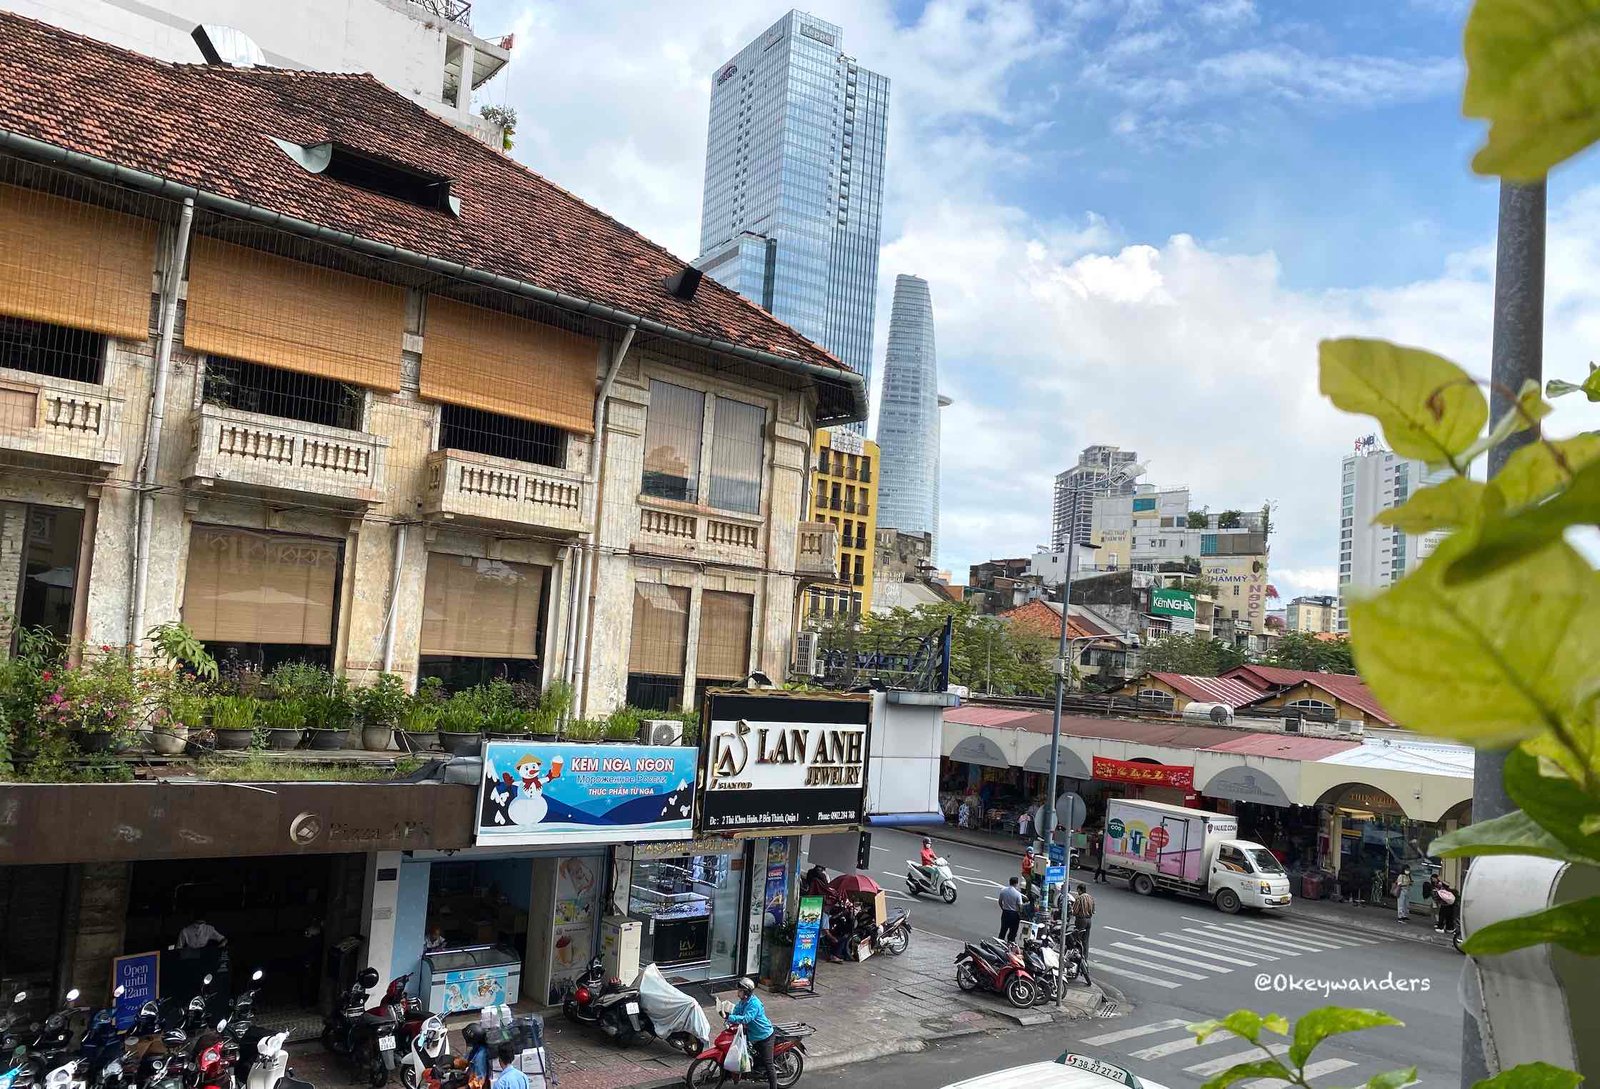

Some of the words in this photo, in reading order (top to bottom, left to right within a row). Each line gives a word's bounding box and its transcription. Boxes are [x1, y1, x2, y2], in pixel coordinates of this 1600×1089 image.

[755, 729, 809, 764] LAN
[812, 730, 864, 764] ANH
[571, 758, 599, 772] KEM
[603, 758, 632, 772] NGA
[636, 758, 674, 772] NGON
[805, 766, 862, 786] JEWELRY
[640, 787, 655, 796] NGA
[124, 965, 148, 977] Open
[125, 974, 147, 987] until
[124, 987, 148, 1000] 12am
